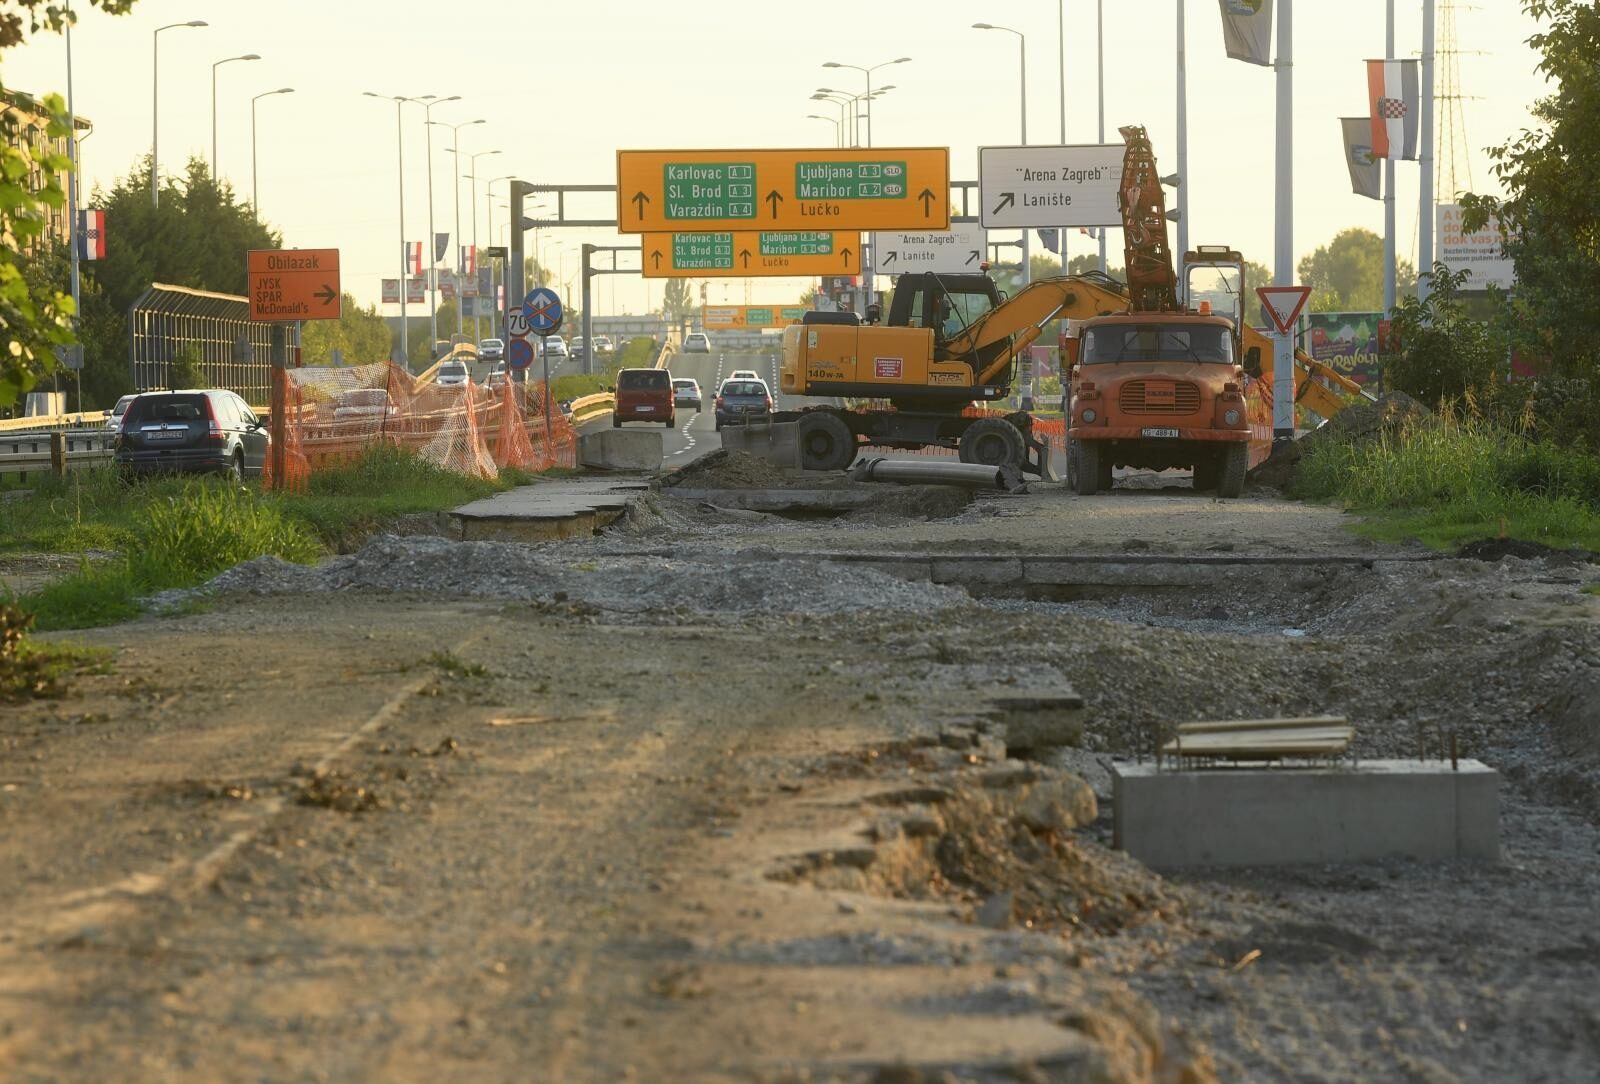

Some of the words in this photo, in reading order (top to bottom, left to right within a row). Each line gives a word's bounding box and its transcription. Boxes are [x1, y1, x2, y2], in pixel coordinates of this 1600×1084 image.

[668, 166, 722, 180] Karlovac
[800, 164, 853, 182] Ljubljana
[886, 167, 900, 175] SLO
[669, 184, 684, 198] Sl.
[692, 184, 721, 198] Brod
[801, 183, 852, 198] Maribor
[1023, 192, 1072, 207] Lanište
[670, 203, 723, 217] Varaždin
[801, 202, 840, 216] Lučko
[675, 233, 711, 243] Karlovac
[762, 232, 798, 244] Ljubljana
[675, 245, 686, 256] Sl.
[691, 246, 711, 256] Brod
[762, 244, 797, 255] Maribor
[267, 255, 319, 270] Obilazak
[256, 278, 281, 290] JYSK
[256, 290, 282, 303] SPAR
[256, 303, 309, 315] McDonald's
[510, 315, 526, 330] 70
